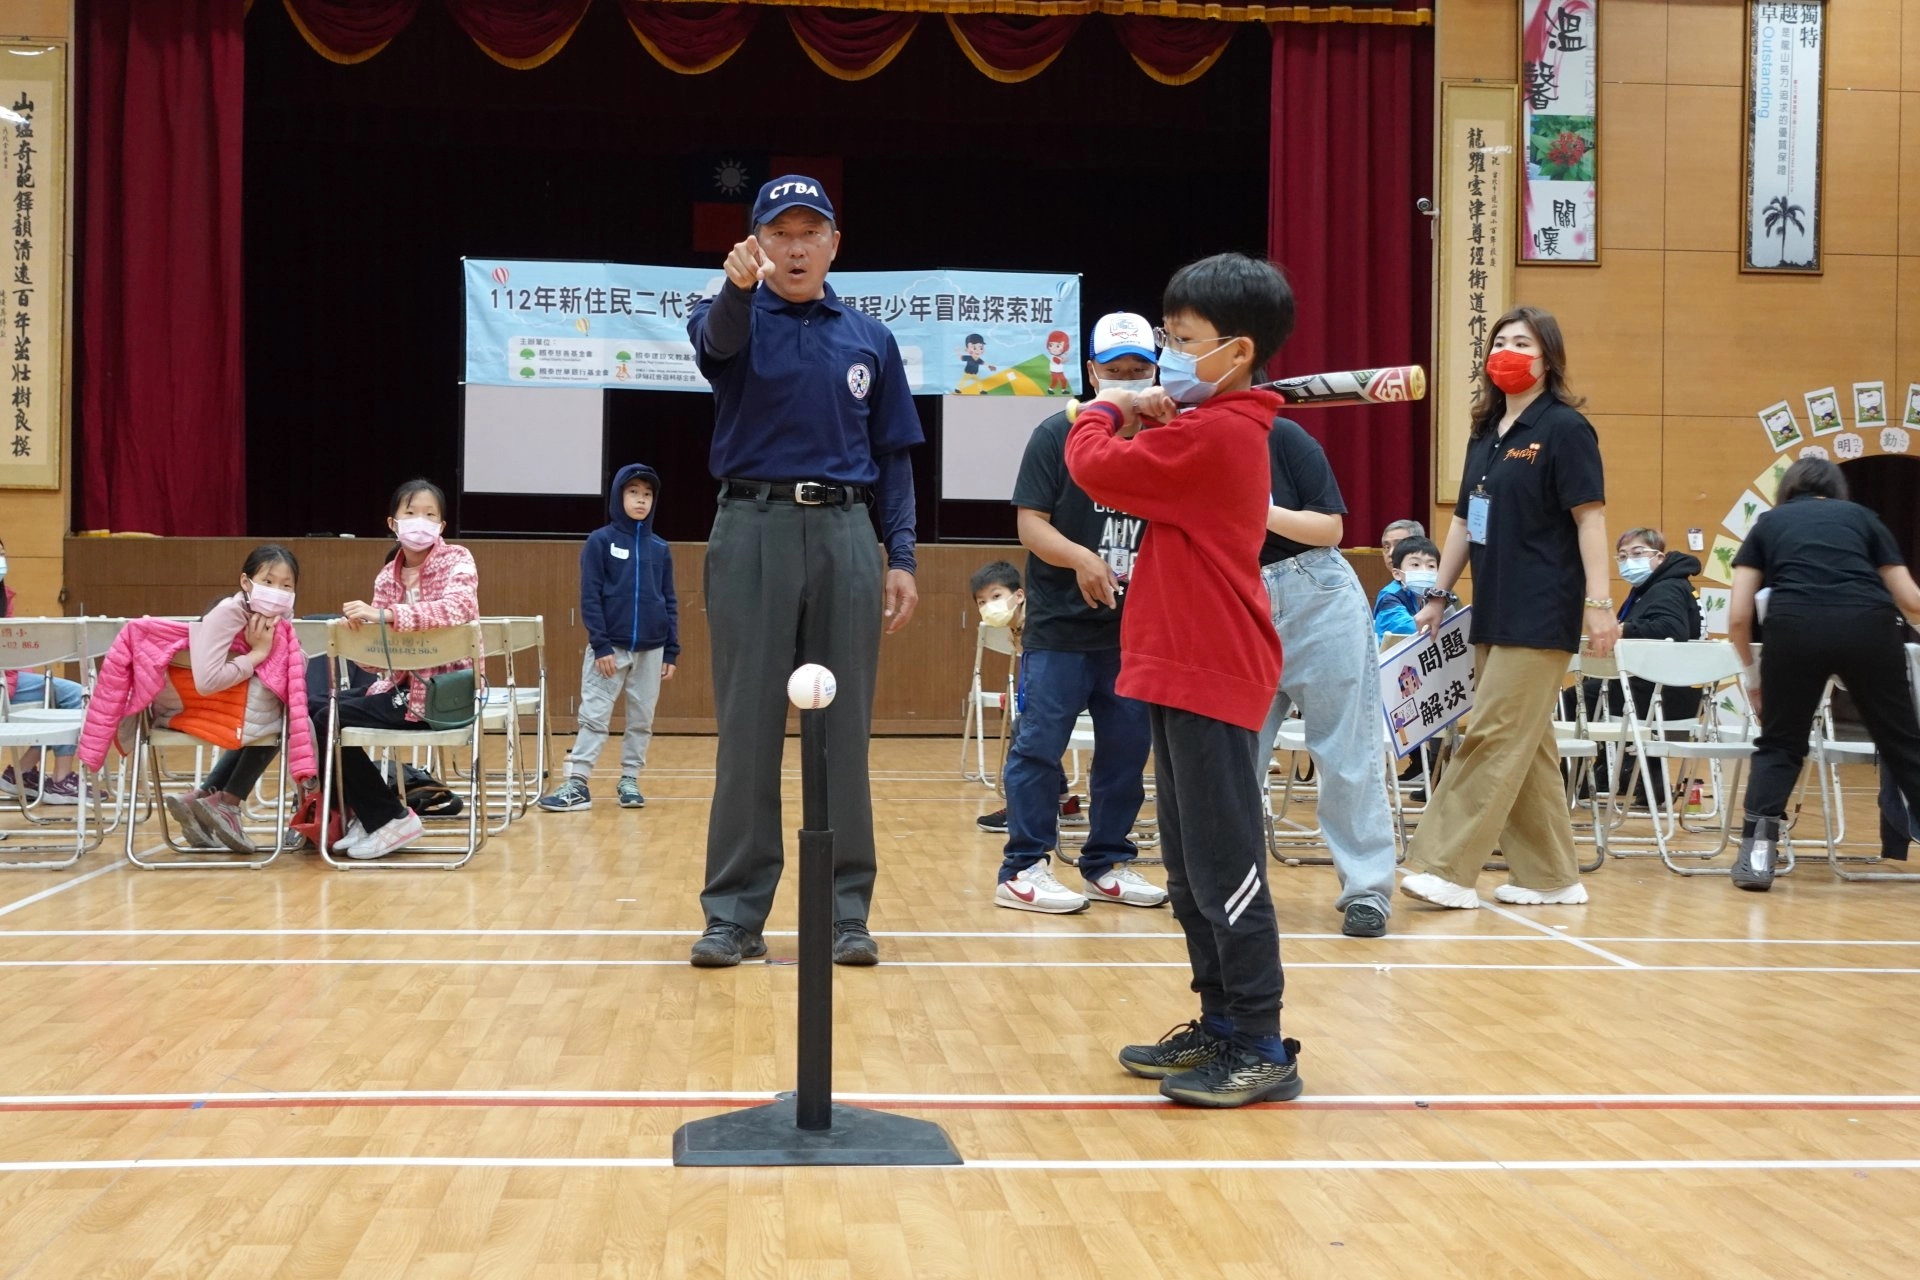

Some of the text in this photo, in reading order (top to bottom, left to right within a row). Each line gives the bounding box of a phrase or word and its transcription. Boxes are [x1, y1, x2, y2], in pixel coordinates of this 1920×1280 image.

[1758, 26, 1776, 119] Outstanding
[769, 182, 819, 200] CTBA
[1533, 199, 1576, 256] 關懷
[1837, 438, 1851, 453] 明
[1418, 627, 1468, 677] 問題
